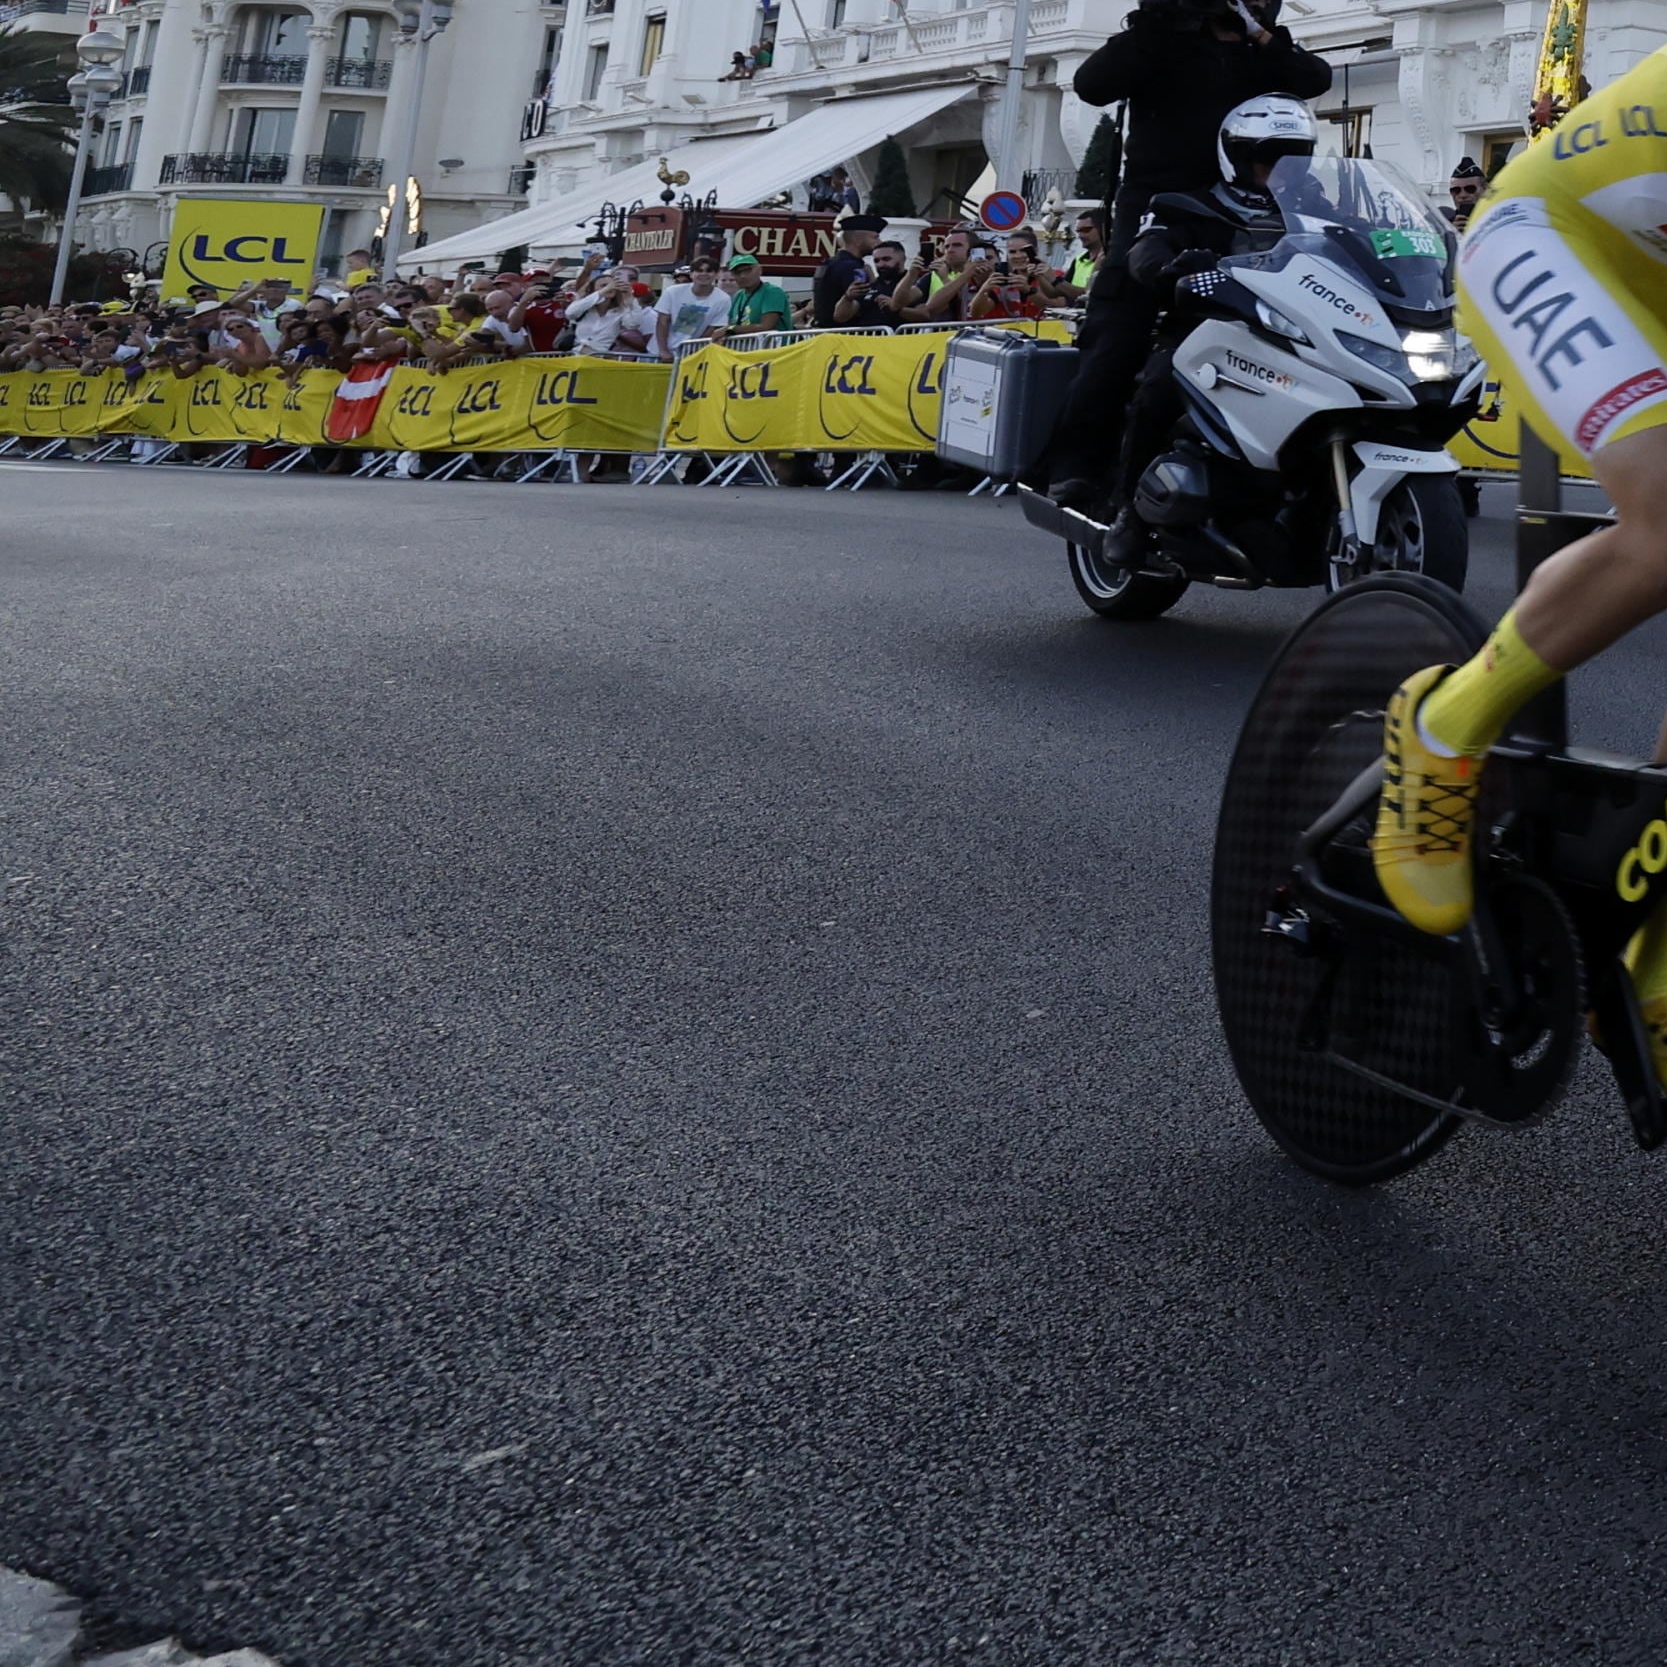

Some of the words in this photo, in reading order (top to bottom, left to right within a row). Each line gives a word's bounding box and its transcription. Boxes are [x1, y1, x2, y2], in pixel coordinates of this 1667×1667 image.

[1553, 121, 1609, 161] LCL
[192, 235, 306, 264] LCL
[1408, 236, 1437, 255] 303
[1491, 249, 1617, 392] UAE
[536, 371, 598, 406] LCL
[729, 361, 779, 400] LCL
[824, 354, 877, 396] LCL
[192, 379, 221, 406] LCL
[399, 385, 436, 416] LCL
[457, 380, 502, 414] LCL
